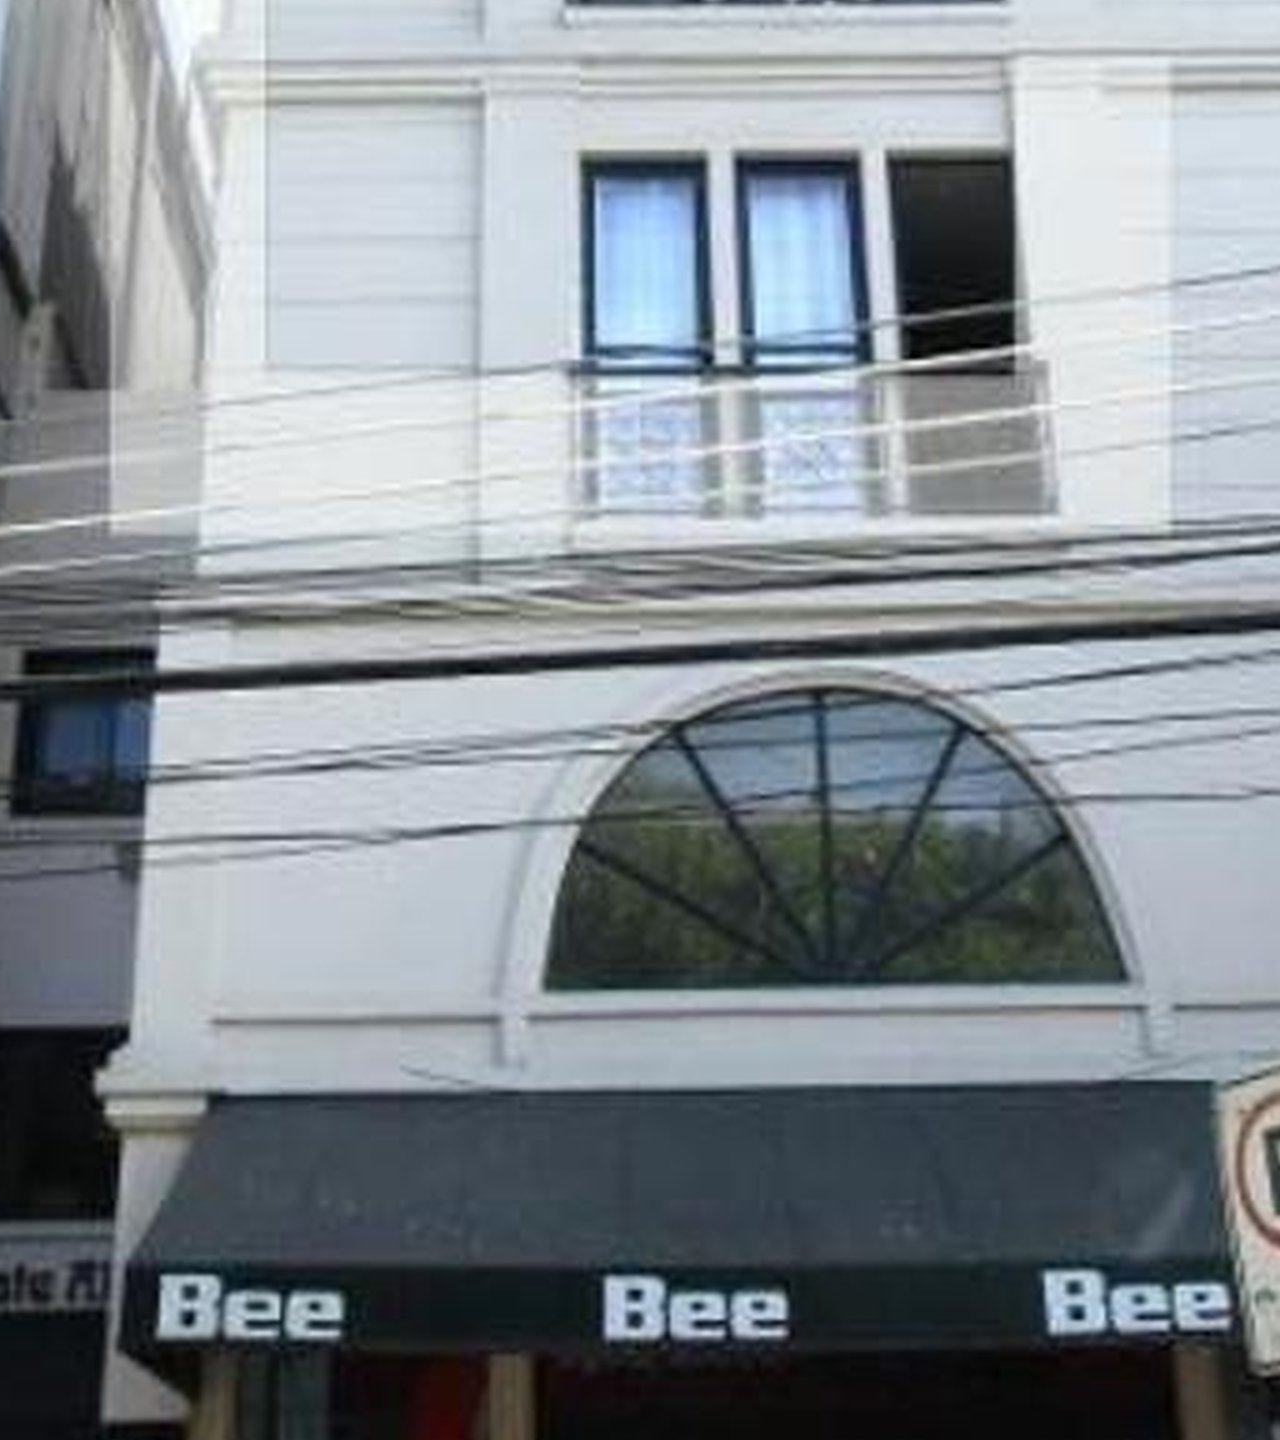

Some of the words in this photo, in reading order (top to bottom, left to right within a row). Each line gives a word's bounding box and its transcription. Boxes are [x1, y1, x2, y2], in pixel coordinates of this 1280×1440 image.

[155, 1273, 346, 1341] Bee
[602, 1274, 790, 1341] Bee
[1042, 1269, 1232, 1336] Bee
